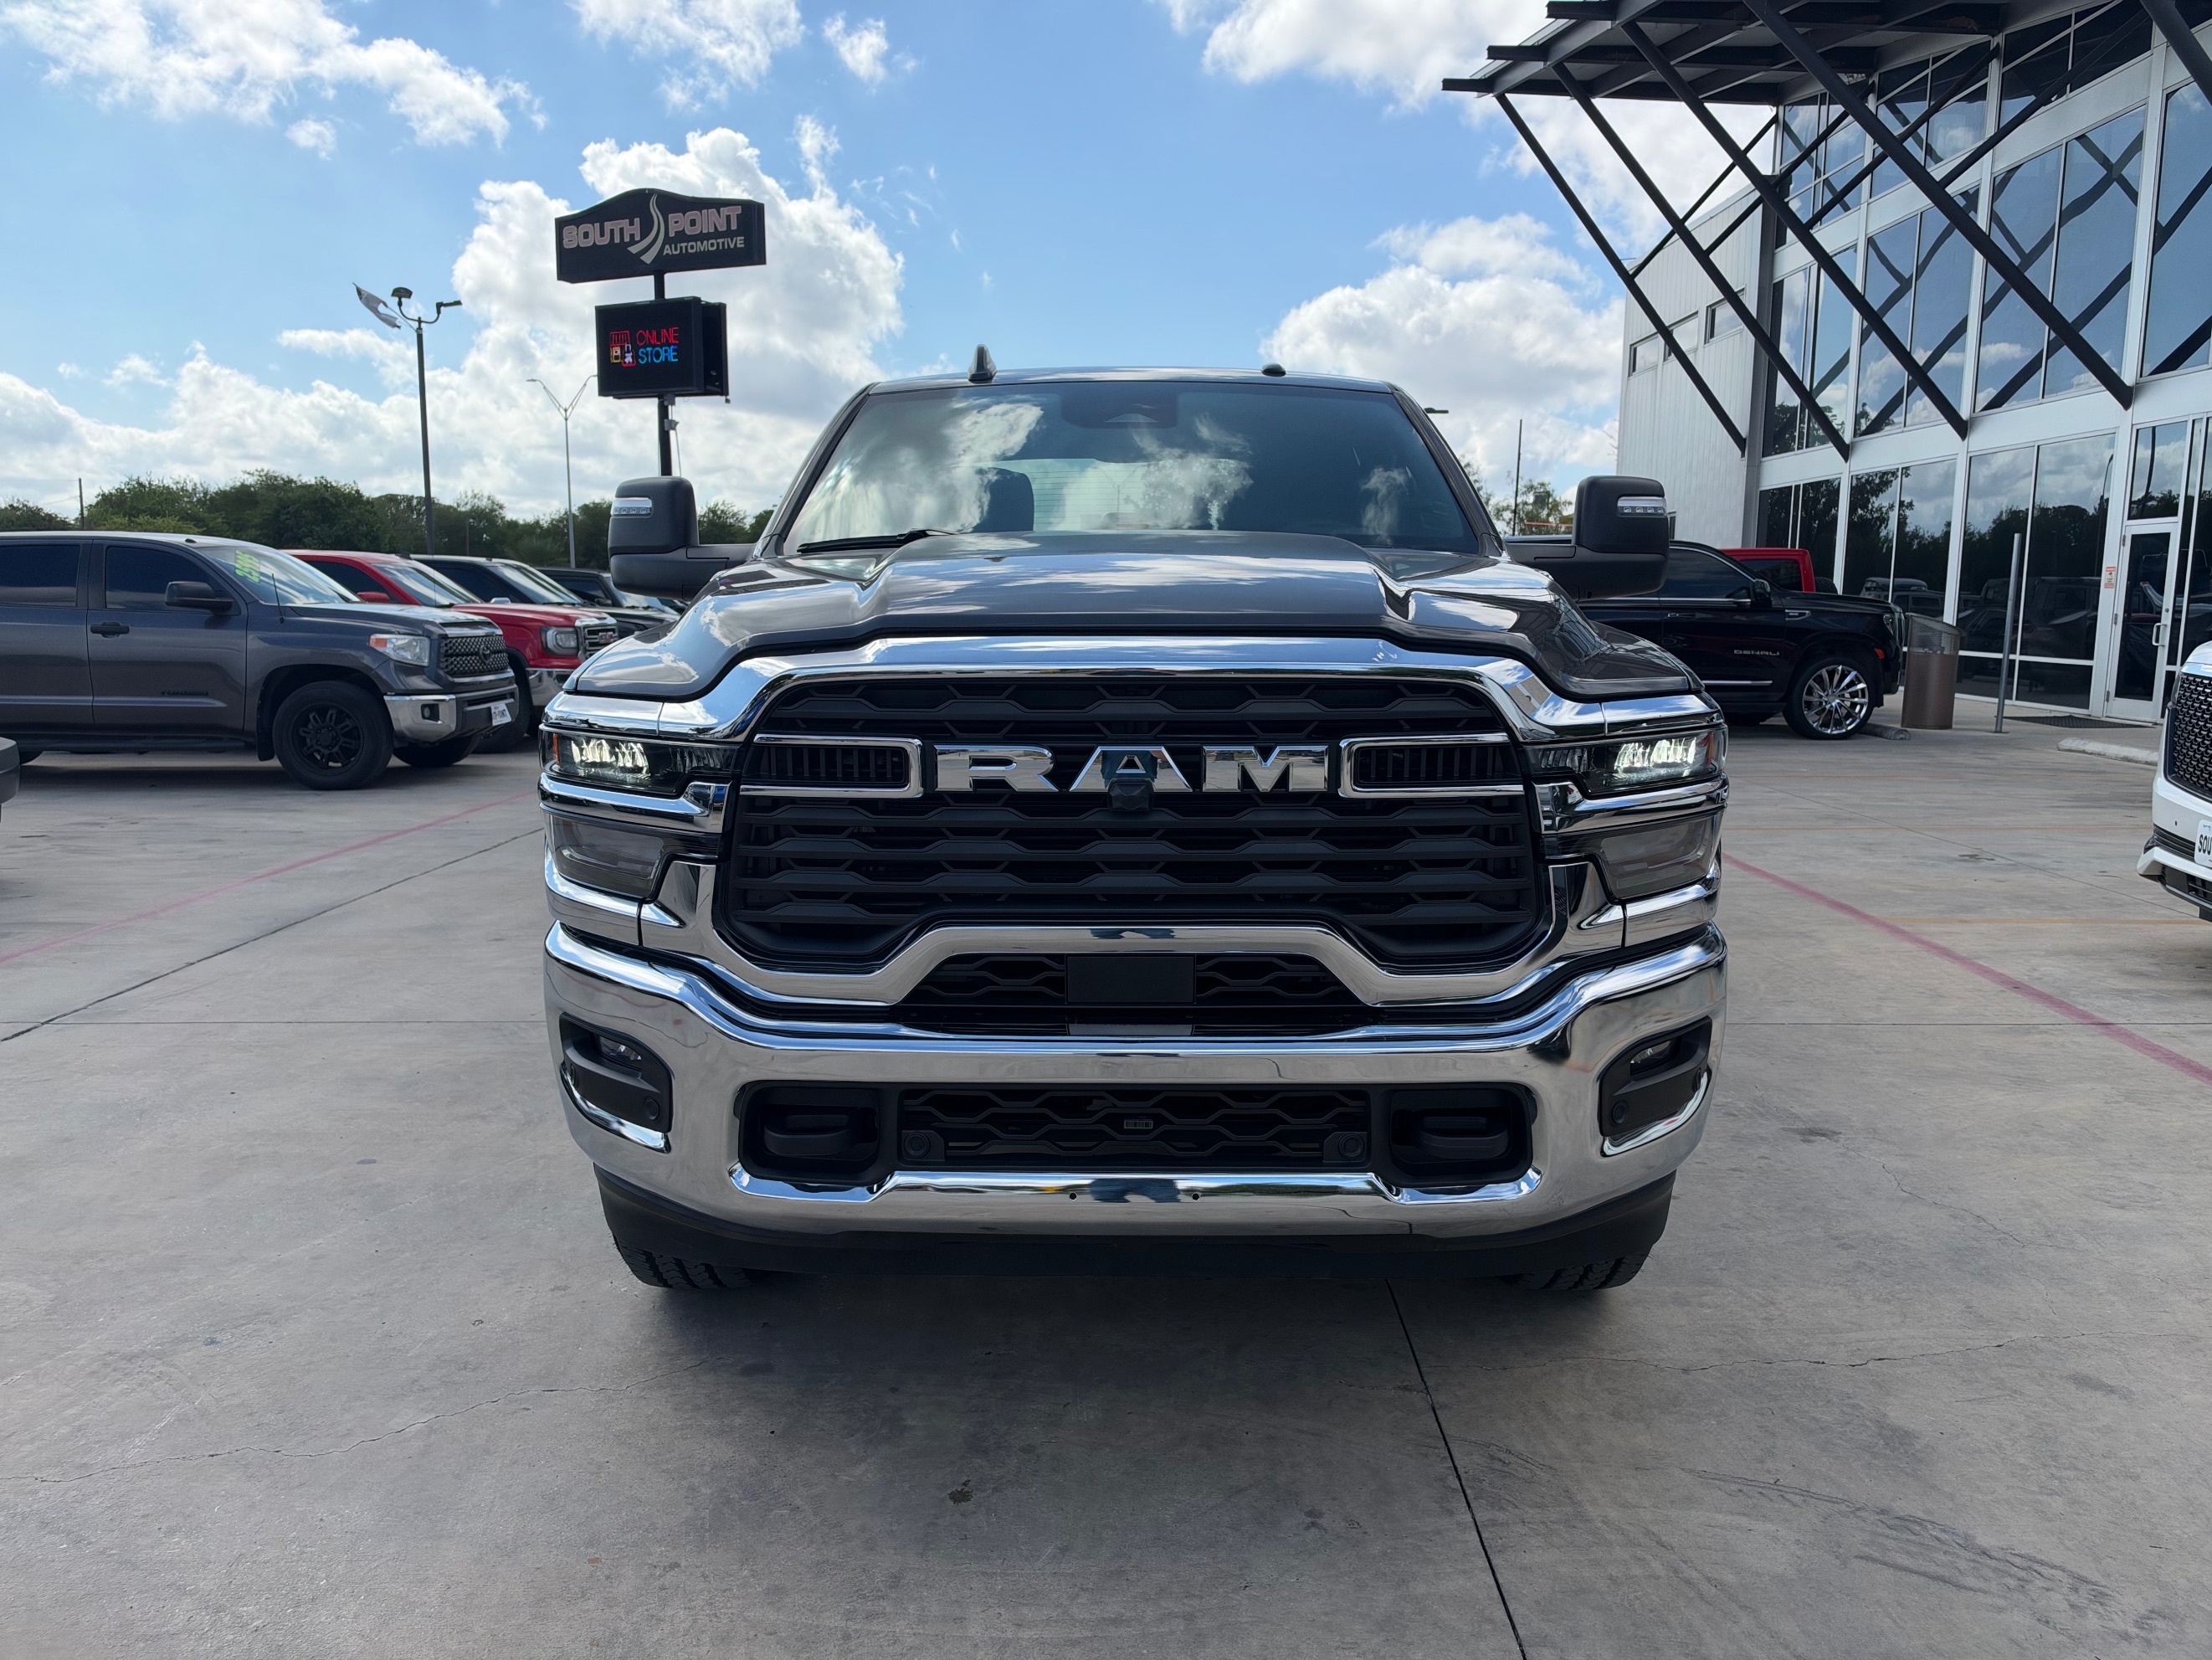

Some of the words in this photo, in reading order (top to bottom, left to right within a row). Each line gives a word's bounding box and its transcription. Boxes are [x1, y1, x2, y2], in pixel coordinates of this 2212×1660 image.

[562, 218, 640, 249] SOUTH
[669, 206, 742, 237] POINT
[663, 236, 744, 255] AUTOMOTIVE
[636, 326, 679, 346] ONLINE
[639, 345, 679, 363] STORE
[934, 744, 1329, 792] RAM
